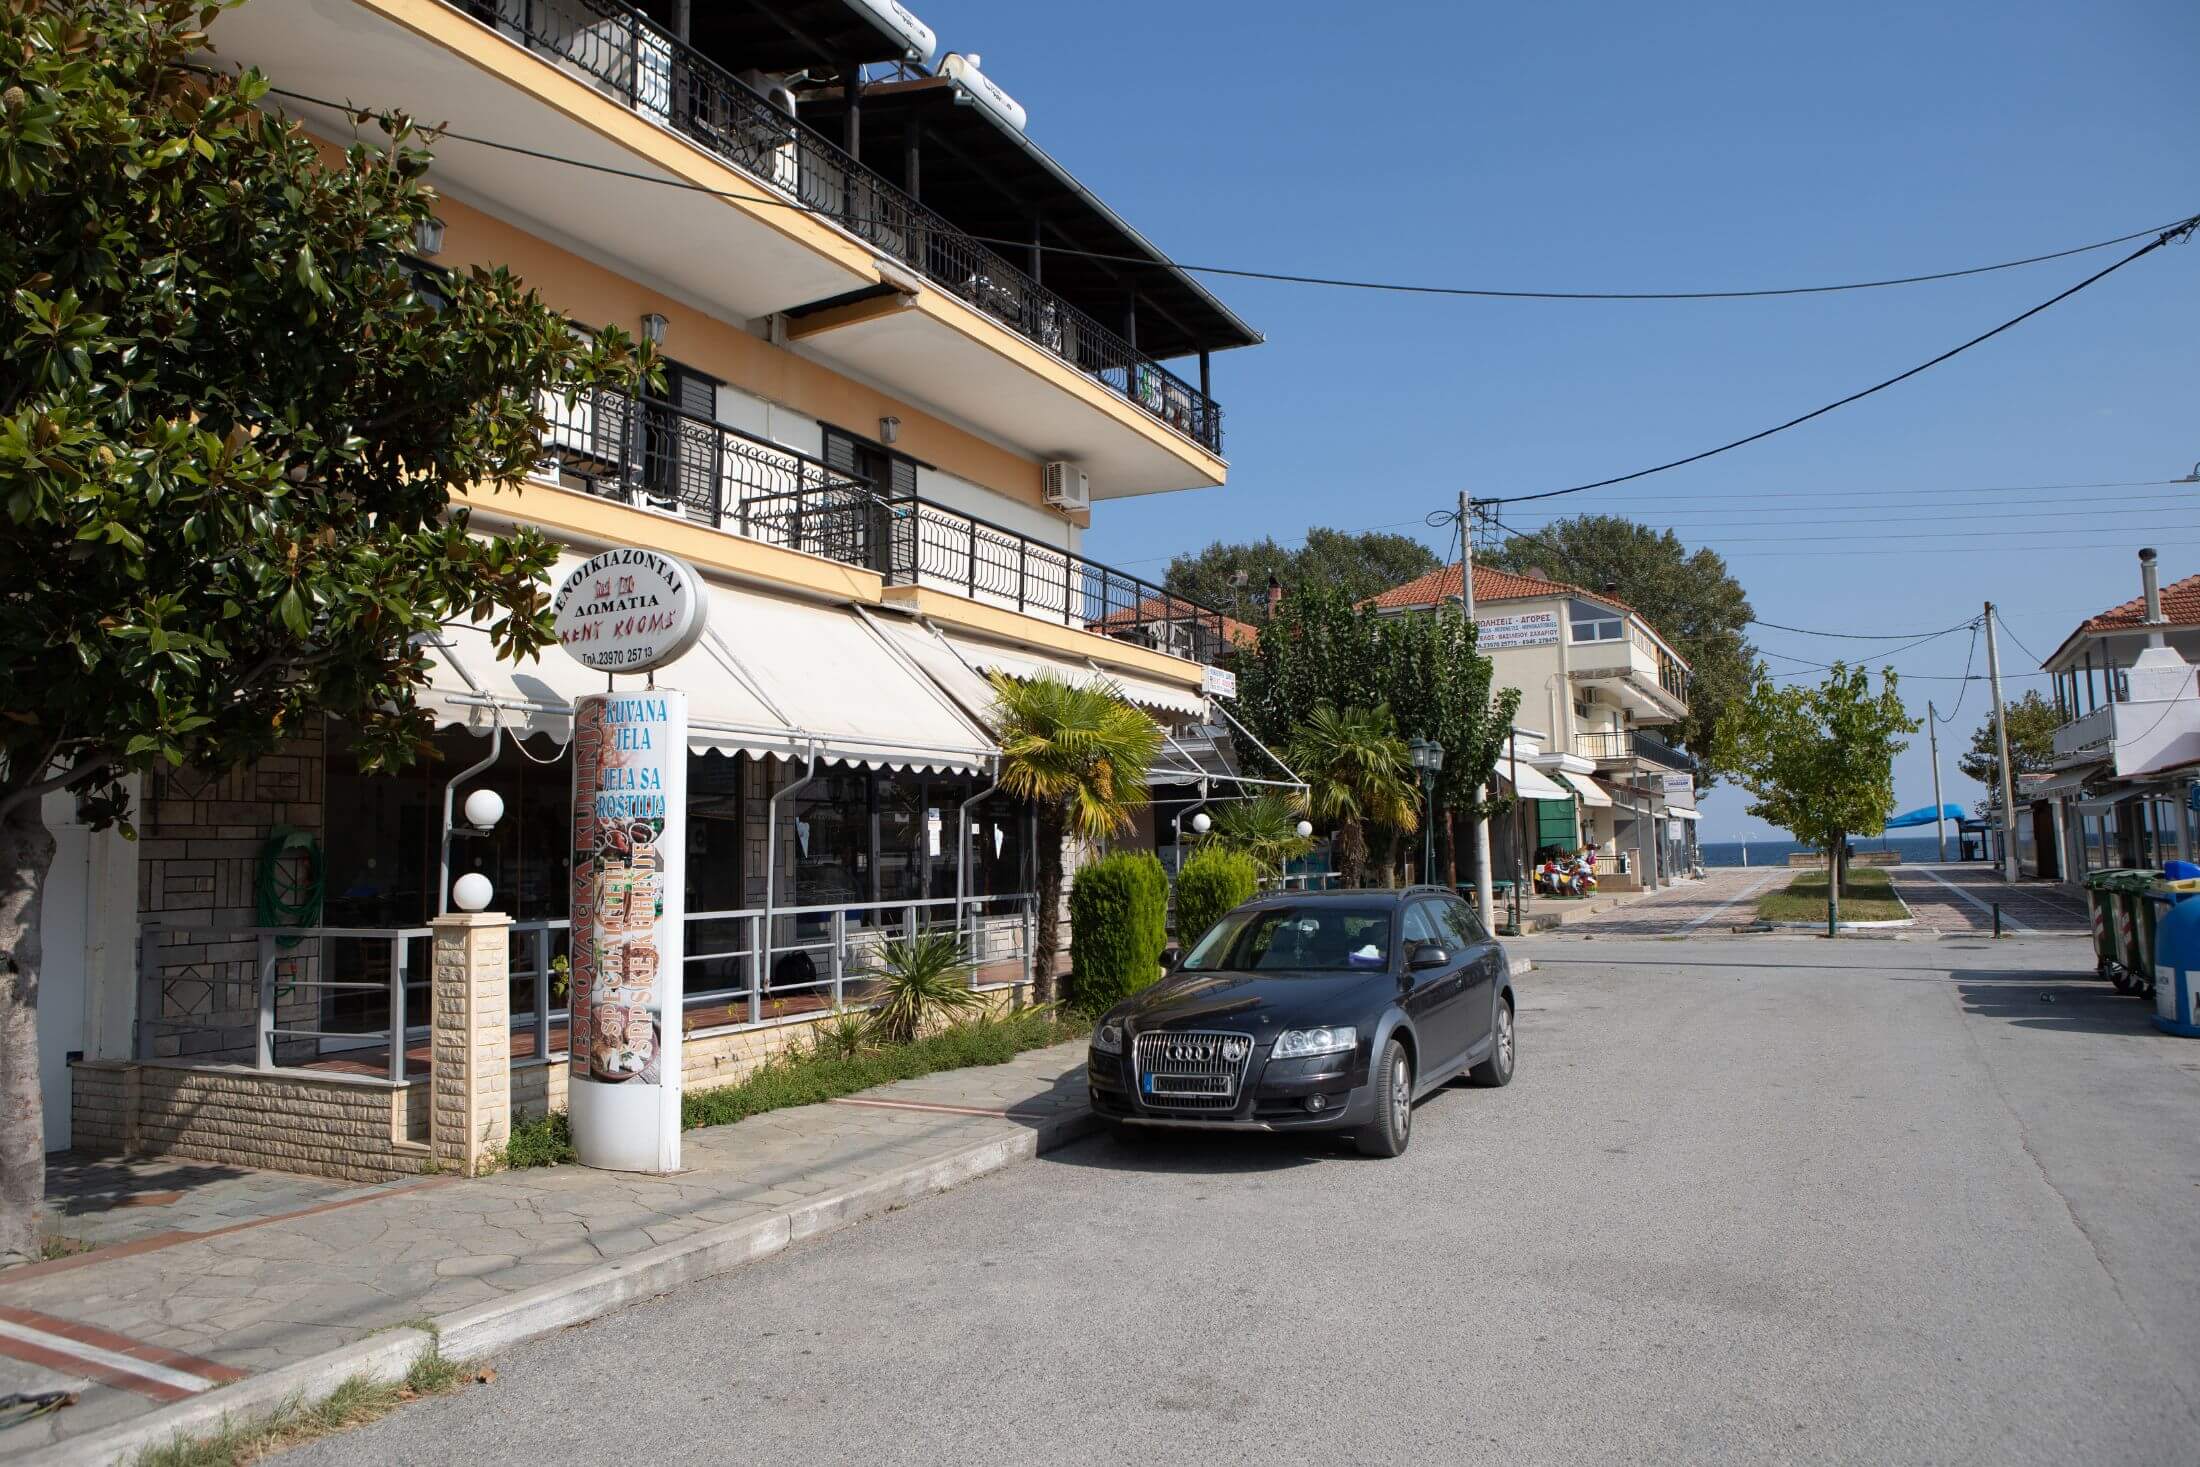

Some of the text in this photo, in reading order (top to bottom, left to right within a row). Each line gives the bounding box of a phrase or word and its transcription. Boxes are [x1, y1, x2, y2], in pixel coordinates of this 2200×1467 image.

[555, 549, 683, 612] ΕΝΟΙΚΙΑΖΟΝΤΑΙ
[574, 594, 660, 618] ΔΩΜΑΤΙΑ
[606, 699, 667, 724] KUVANA
[616, 727, 652, 752] JELA
[575, 704, 602, 852] KUHINJA
[603, 767, 662, 791] JELA SA
